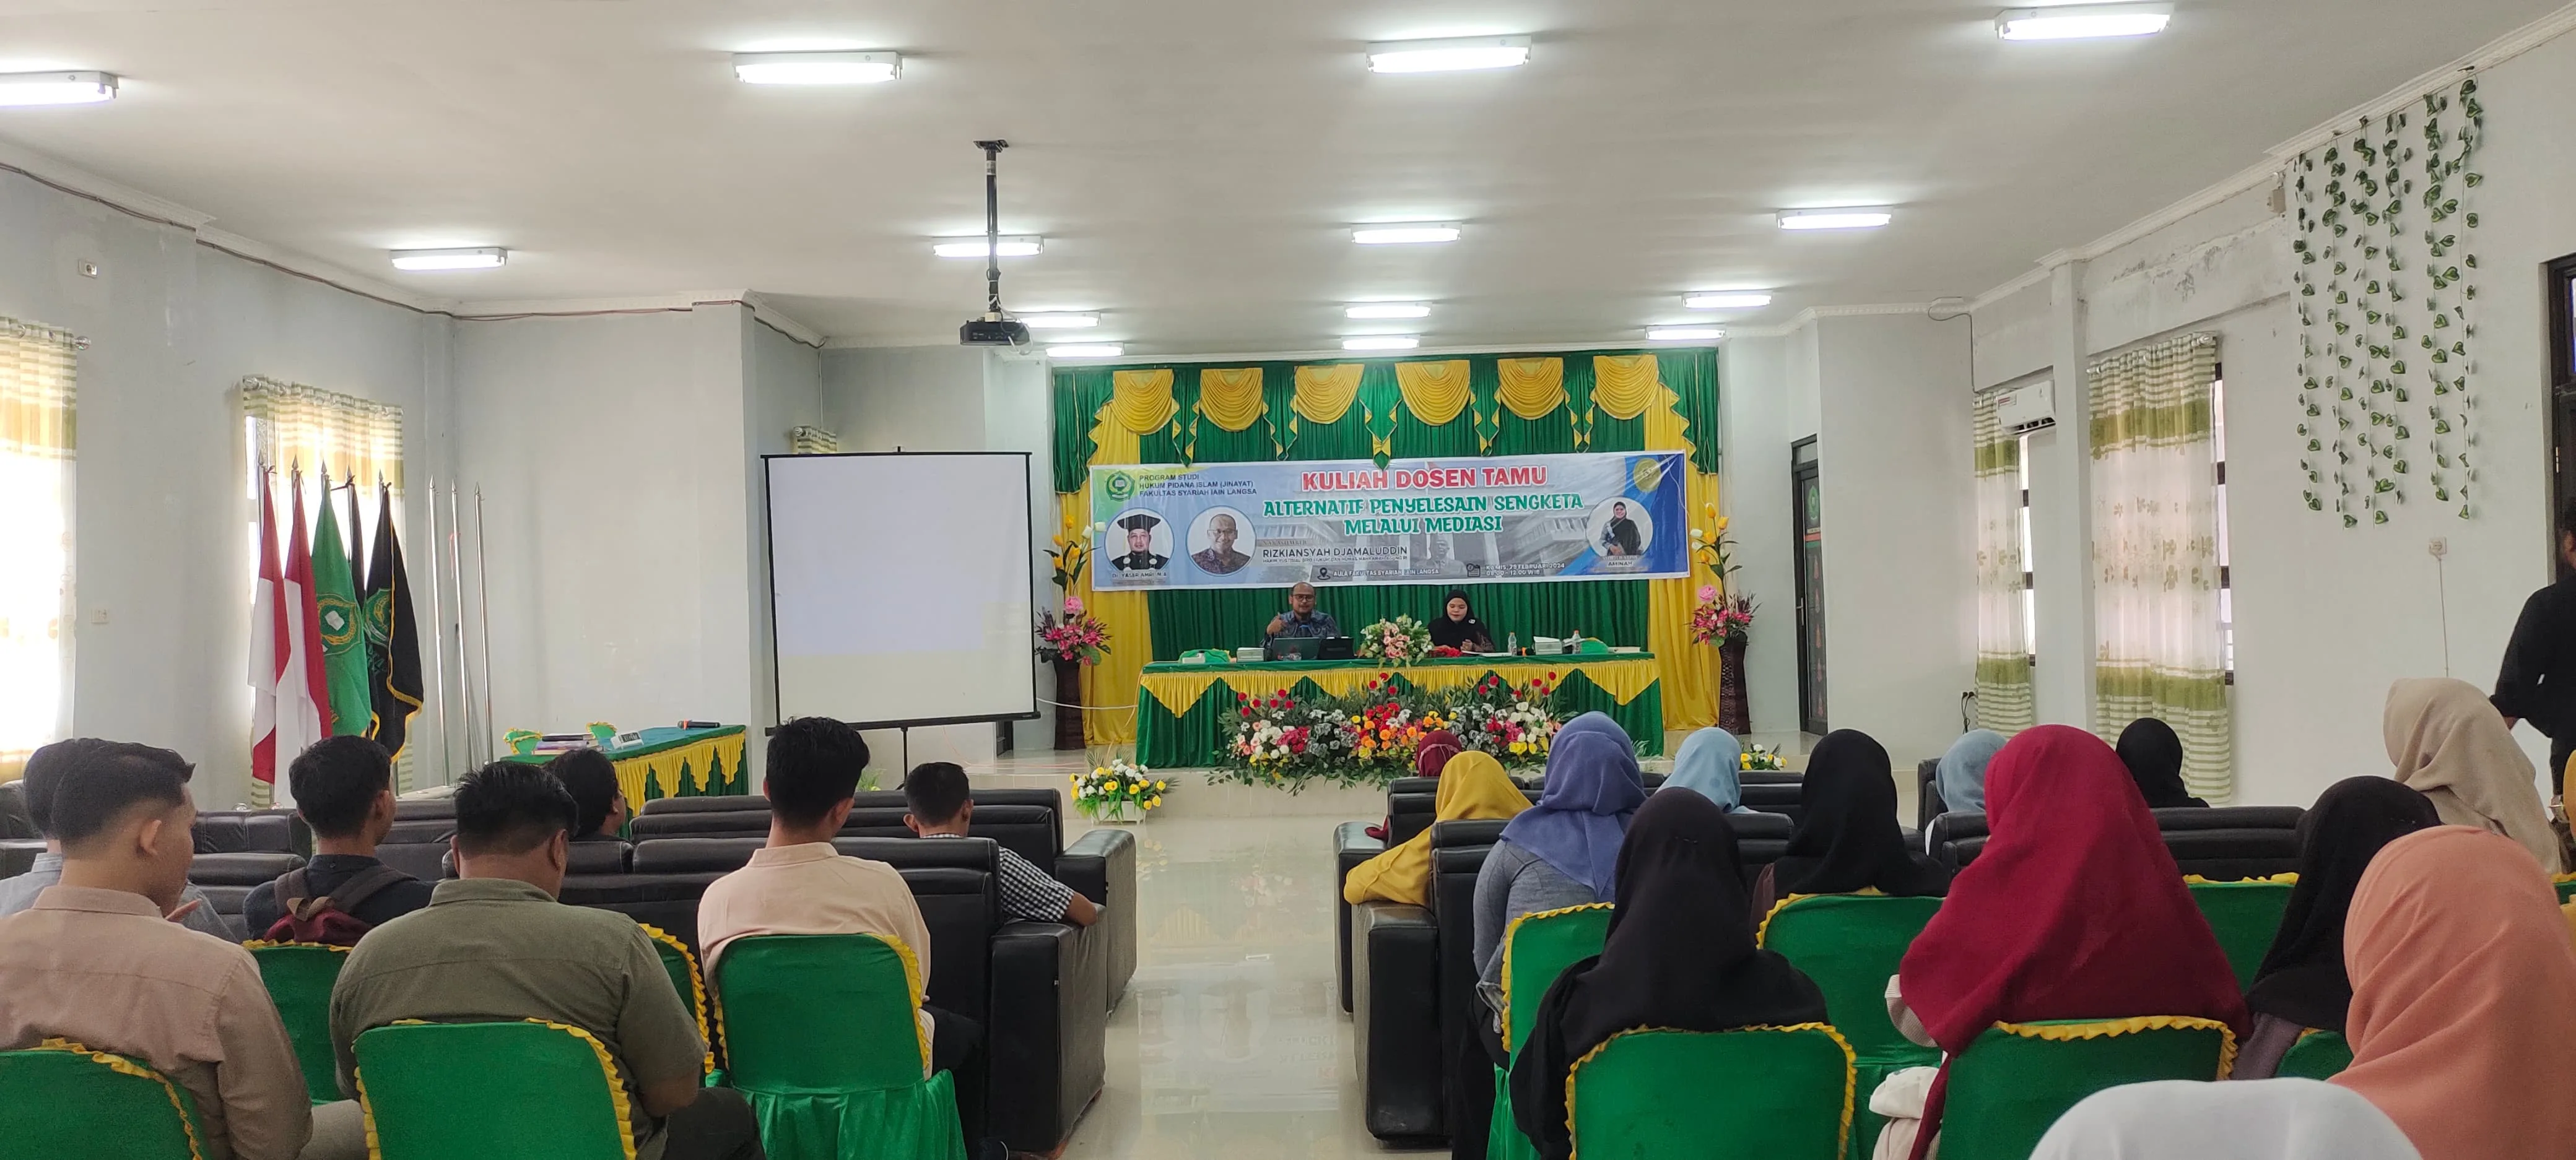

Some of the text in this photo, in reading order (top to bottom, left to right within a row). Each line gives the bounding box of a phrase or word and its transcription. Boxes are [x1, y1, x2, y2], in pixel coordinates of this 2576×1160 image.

[1302, 467, 1546, 490] KULIAH DOSEN TAMU
[1264, 493, 1583, 516] ALTERNATIF PENYELESAIN SENGKETA
[1344, 516, 1502, 535] MELALUI MEDIASI
[1263, 547, 1407, 558] RIZKIANSYAH DJAMALUDDIN
